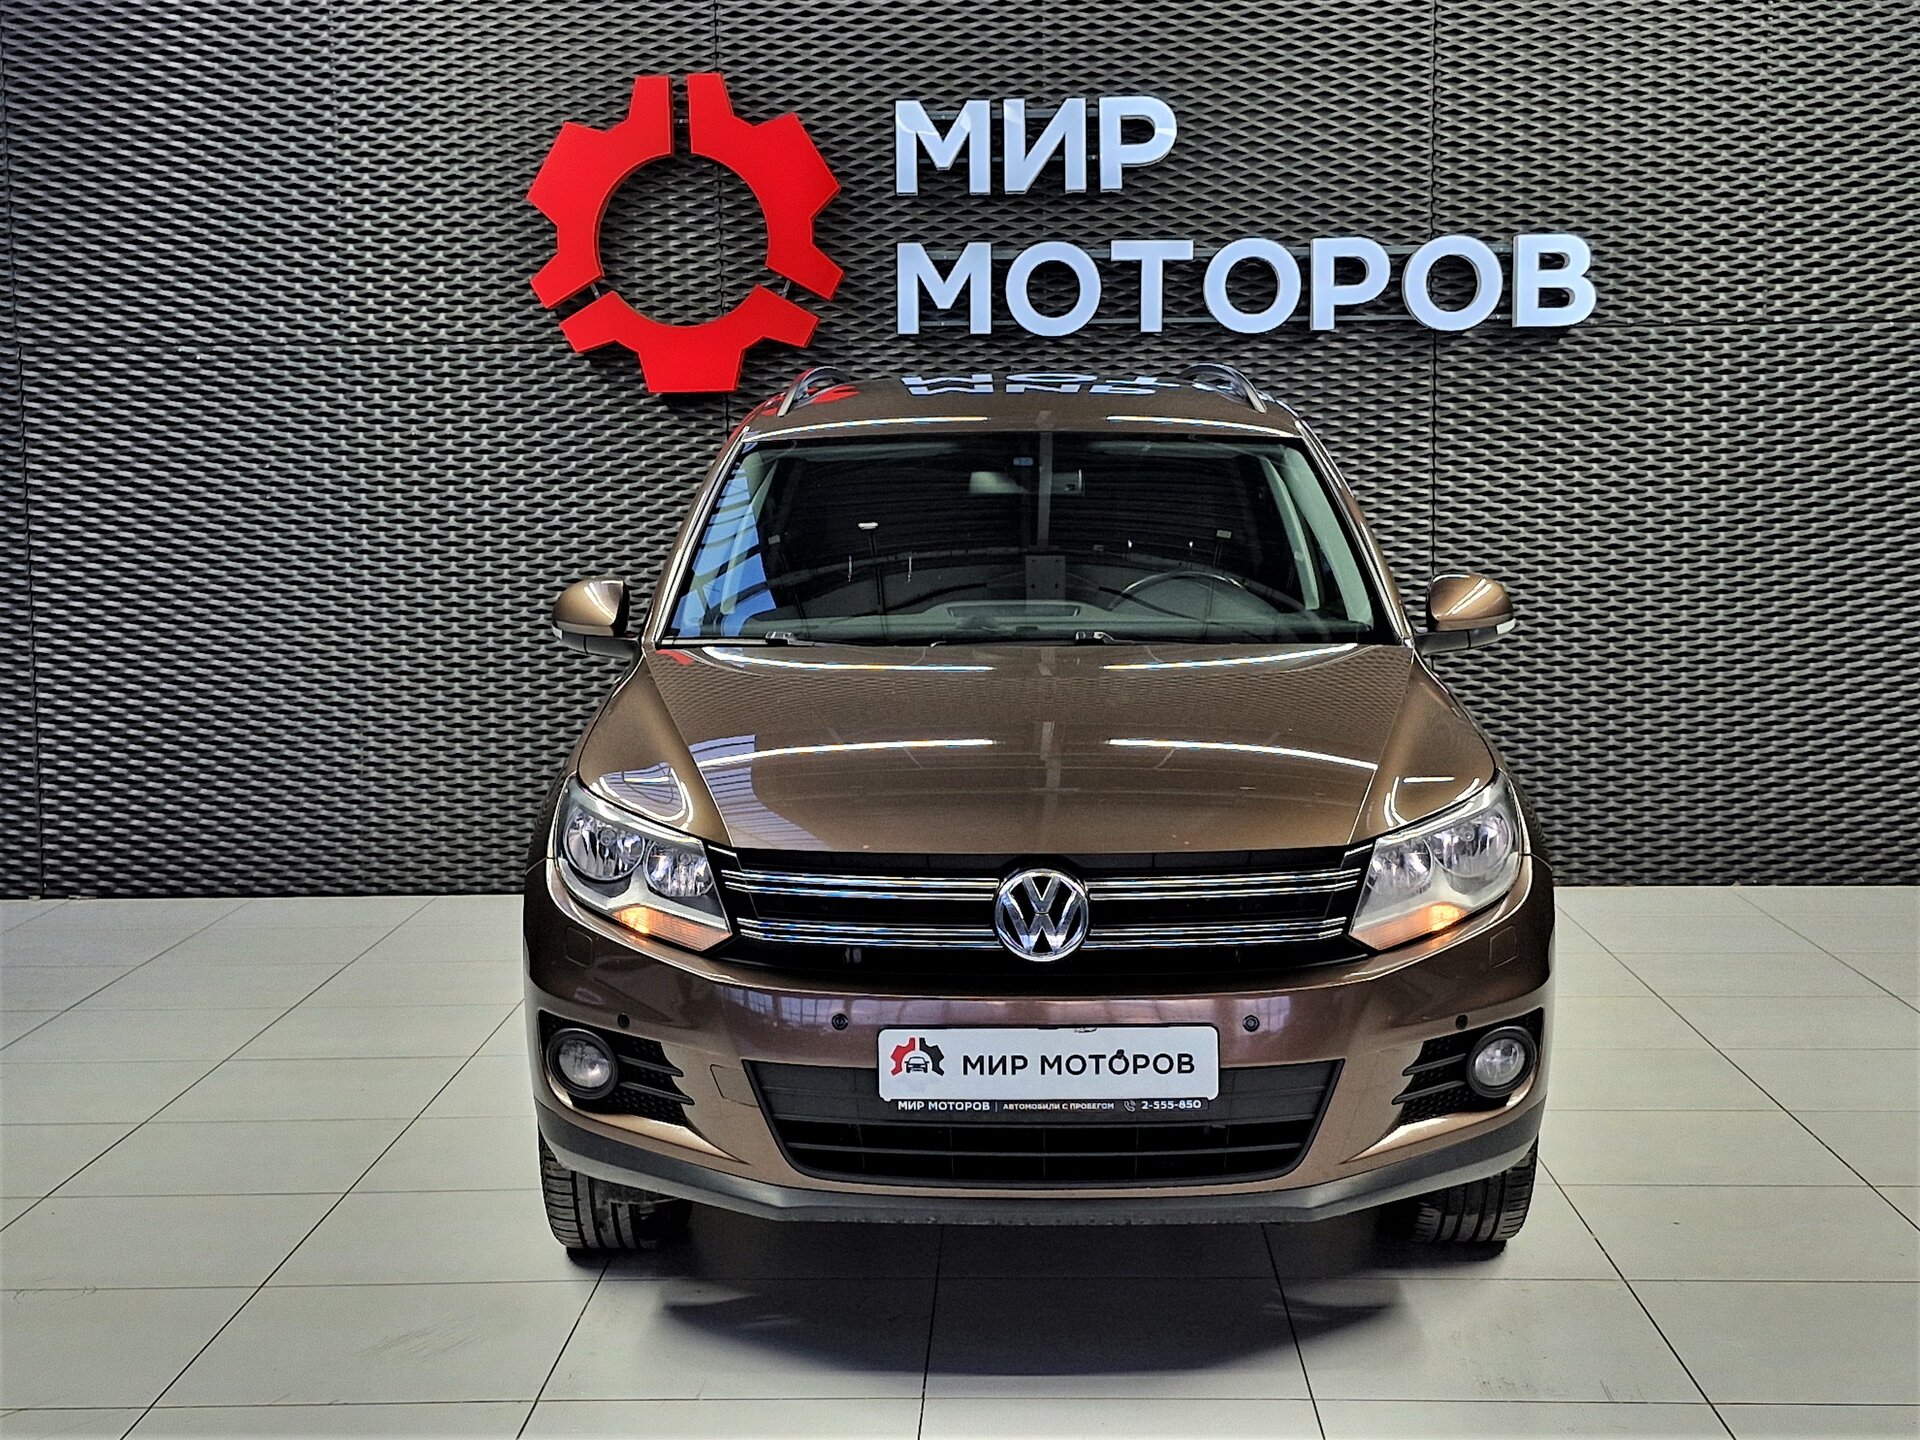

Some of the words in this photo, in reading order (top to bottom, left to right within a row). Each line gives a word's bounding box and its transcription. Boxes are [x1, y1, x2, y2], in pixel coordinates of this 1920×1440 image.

[895, 96, 1178, 196] МИР
[896, 234, 1598, 337] МОТОРОВ
[962, 1054, 1029, 1076] МИР
[1040, 1053, 1195, 1076] МОТОРОВ
[897, 1101, 925, 1111] МИР
[928, 1101, 991, 1111] МОТОРОВ
[1002, 1102, 1061, 1111] АВТОМОБИЛИ
[1061, 1102, 1069, 1110] С
[1069, 1102, 1115, 1110] ПРОБЕГОМ
[1140, 1099, 1202, 1110] 2-555-850
